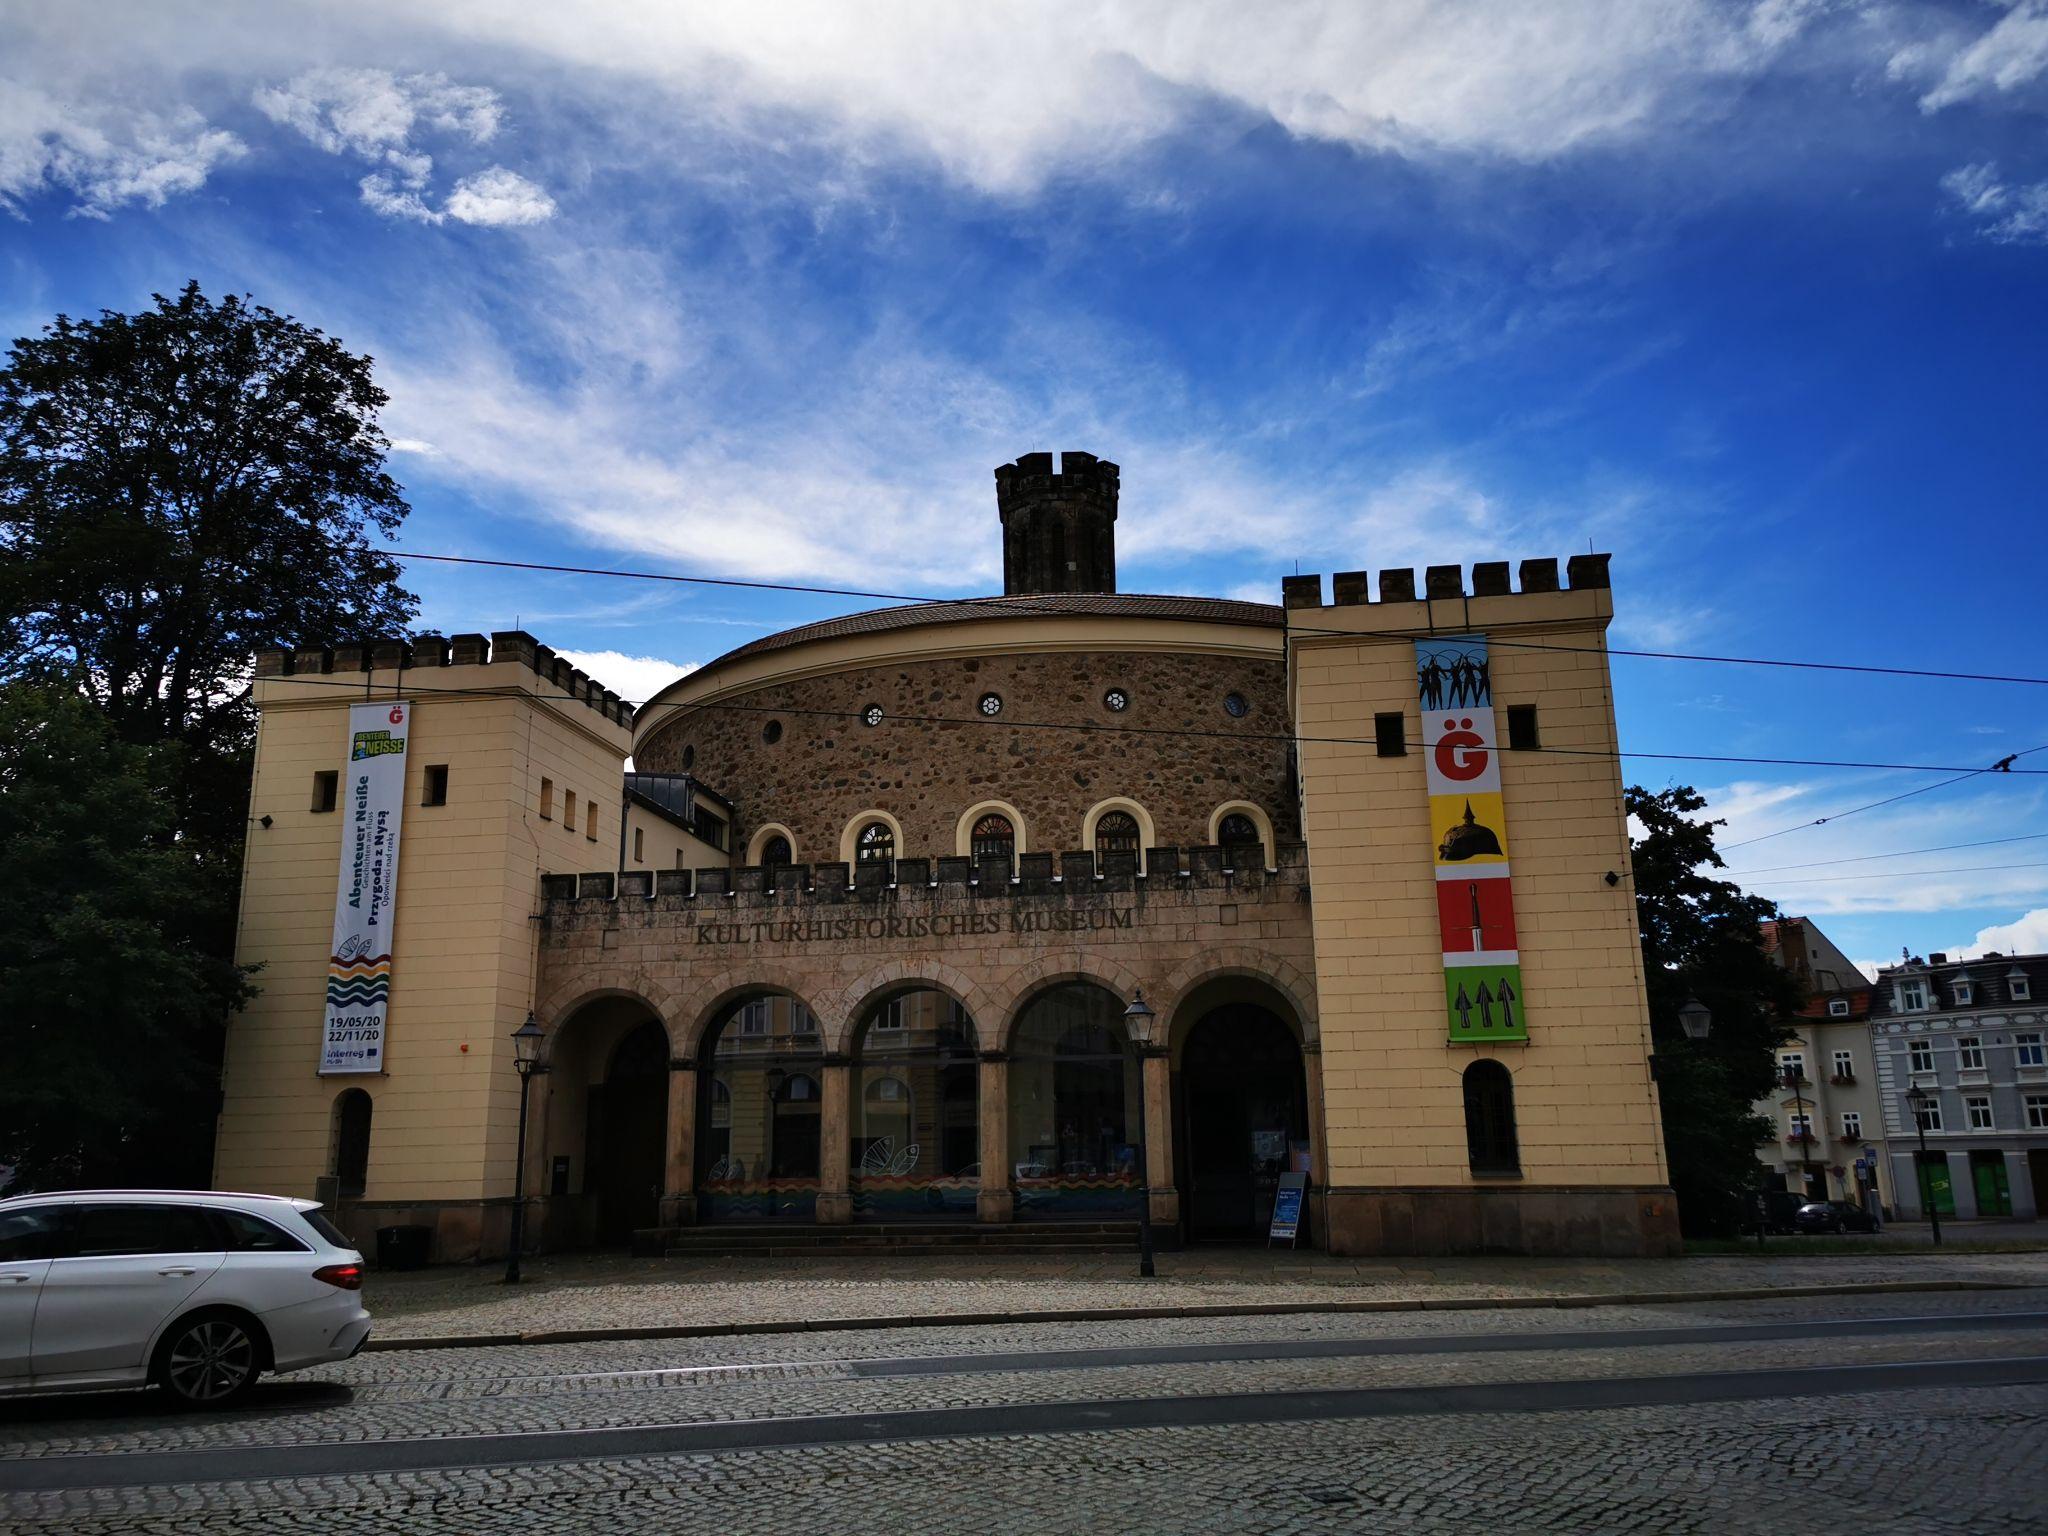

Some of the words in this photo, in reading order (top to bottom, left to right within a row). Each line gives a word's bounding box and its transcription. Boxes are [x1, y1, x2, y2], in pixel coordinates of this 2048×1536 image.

[366, 740, 403, 754] NEISSE
[356, 776, 369, 822] Neiße
[365, 811, 374, 830] Fluss
[374, 810, 389, 846] Nysą
[366, 831, 372, 843] am
[386, 833, 395, 852] rzeką
[375, 848, 383, 856] z
[384, 853, 393, 867] nad
[348, 826, 365, 909] Abenteuer
[361, 845, 371, 889] Geschichten
[367, 859, 383, 926] Przygoda
[381, 869, 391, 907] Opowieści
[696, 912, 1001, 945] KULTURHISTORISCHES
[1009, 907, 1133, 933] MUSEUM
[330, 1016, 380, 1028] 19/05/20
[328, 1030, 379, 1042] 22/11/20
[327, 1050, 364, 1059] Interreg
